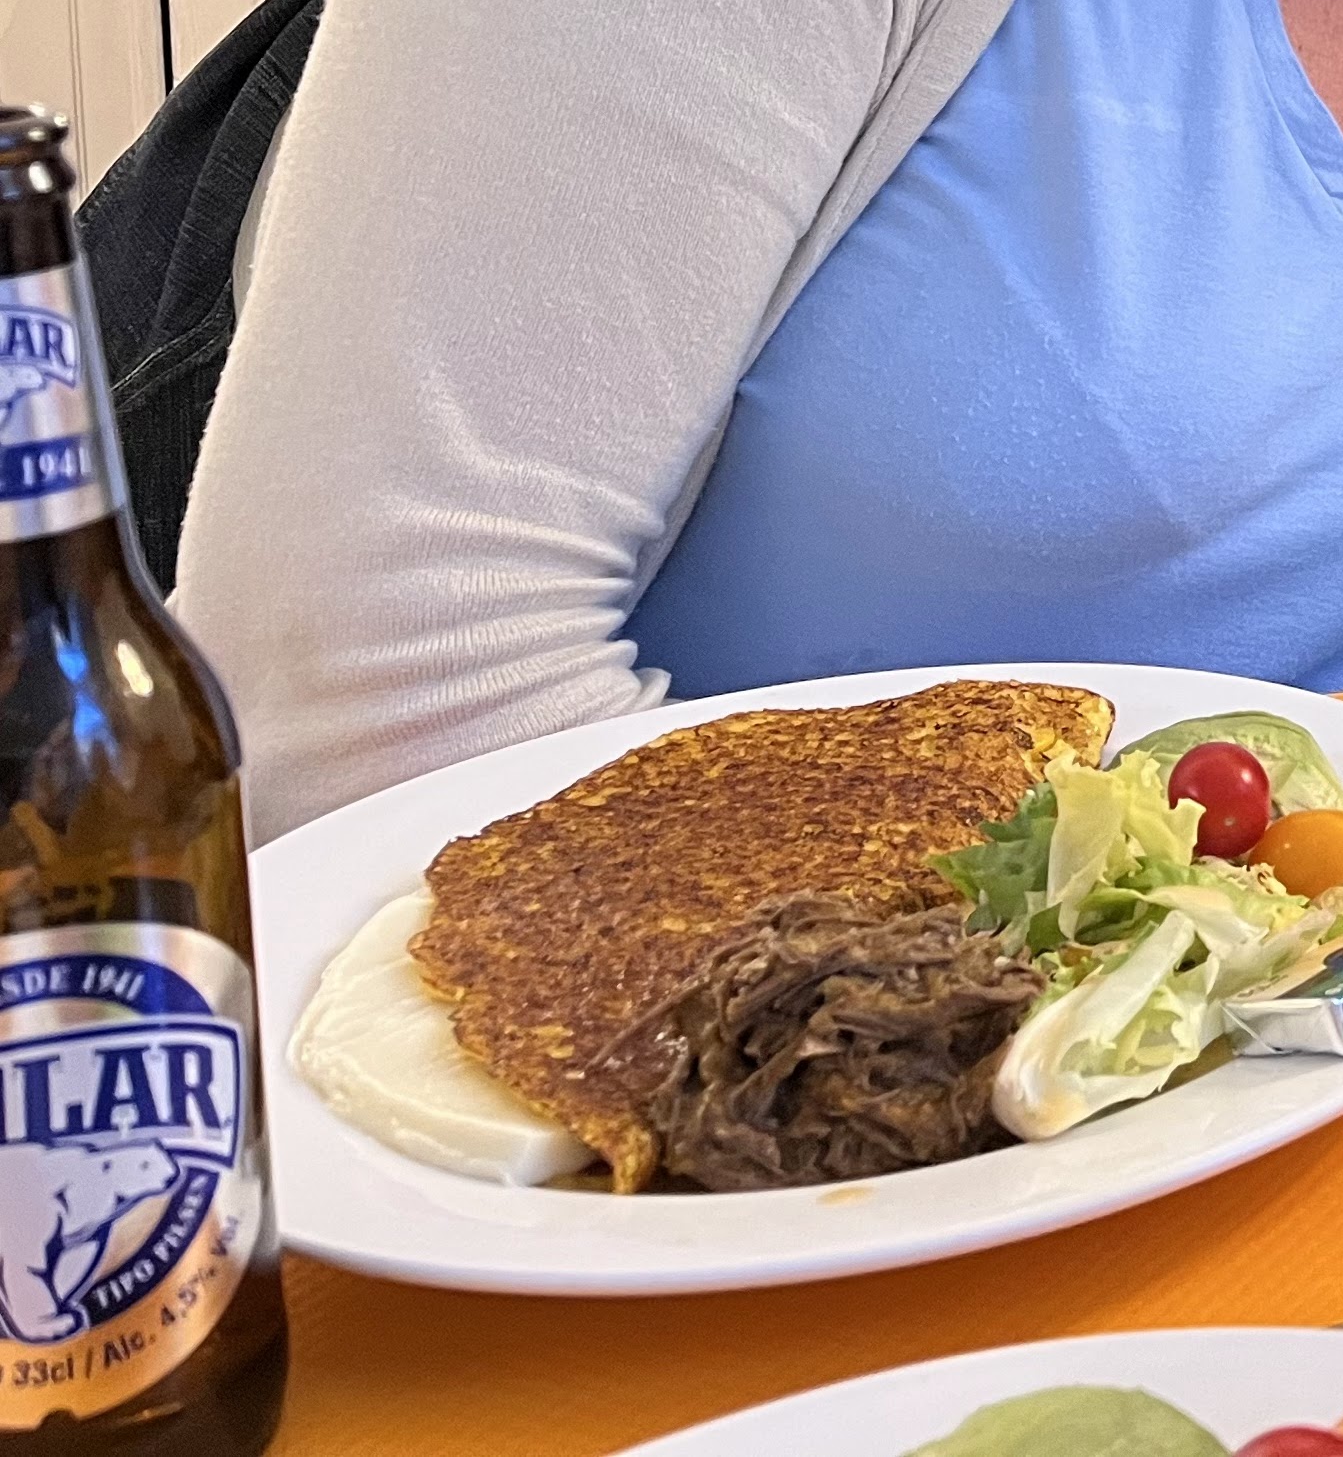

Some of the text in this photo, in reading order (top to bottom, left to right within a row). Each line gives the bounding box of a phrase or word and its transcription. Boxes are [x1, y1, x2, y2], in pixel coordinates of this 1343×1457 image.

[0, 963, 71, 996] SDE
[0, 1043, 222, 1143] LAR
[94, 1258, 155, 1309] TIPO
